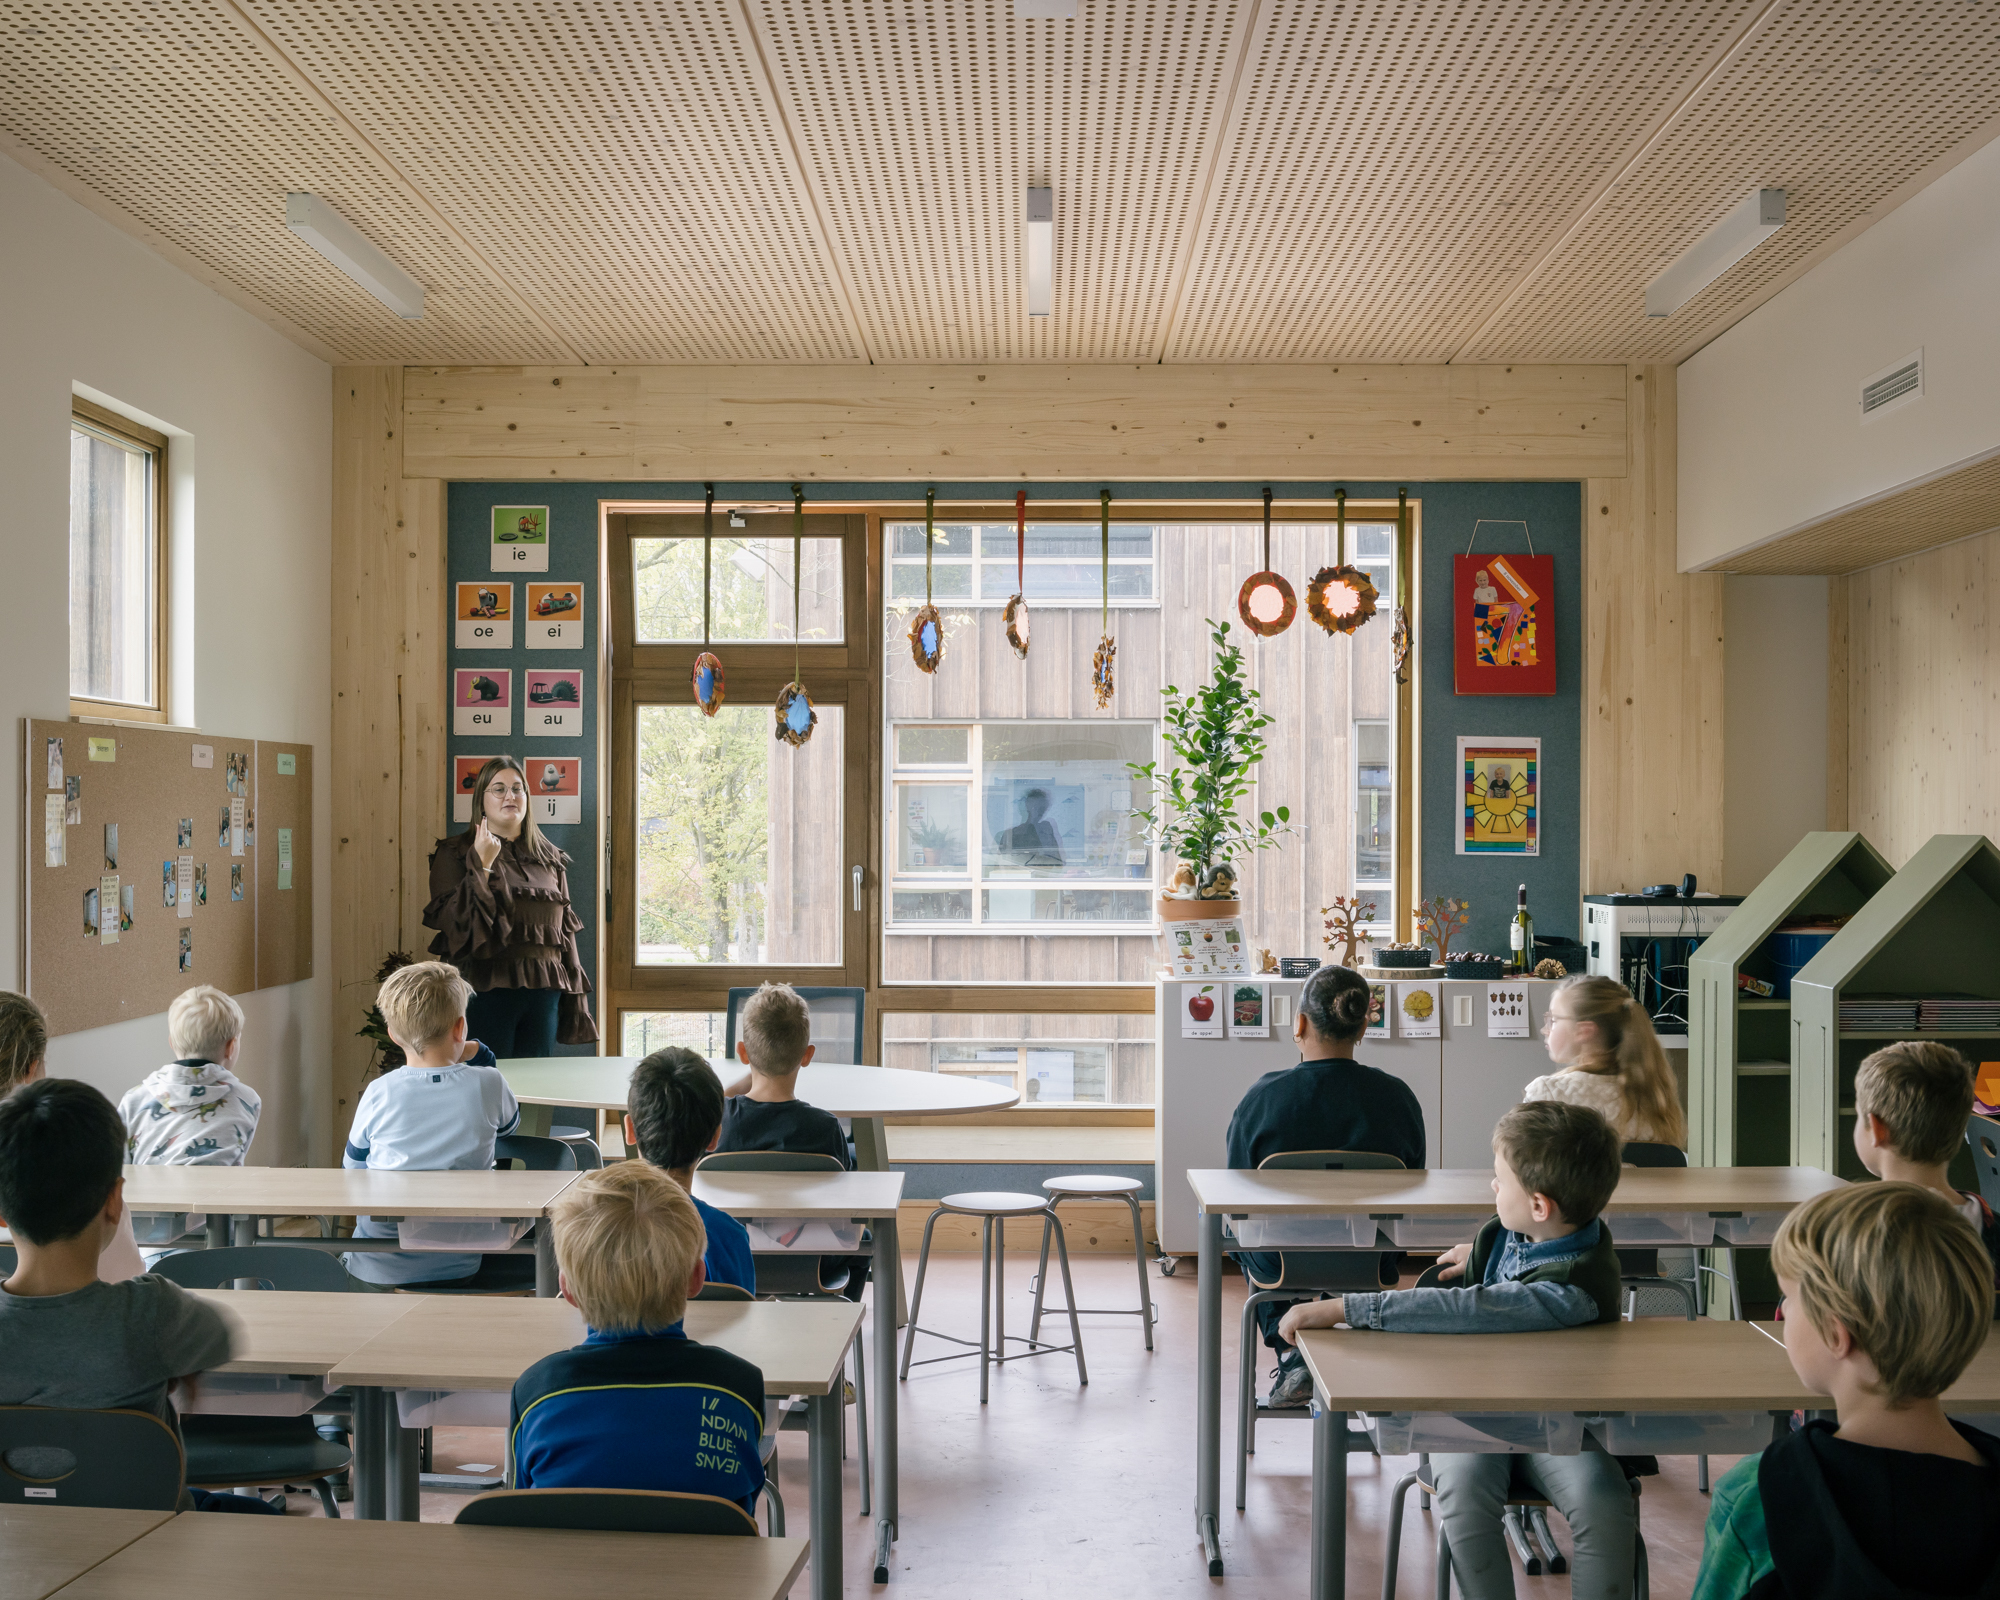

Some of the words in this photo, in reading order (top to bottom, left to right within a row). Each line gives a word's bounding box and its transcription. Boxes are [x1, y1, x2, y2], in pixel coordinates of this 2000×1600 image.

[512, 547, 527, 561] ie
[474, 626, 494, 638] oe
[547, 624, 562, 638] ei
[472, 713, 492, 725] eu
[543, 714, 563, 725] au
[547, 799, 556, 817] ij
